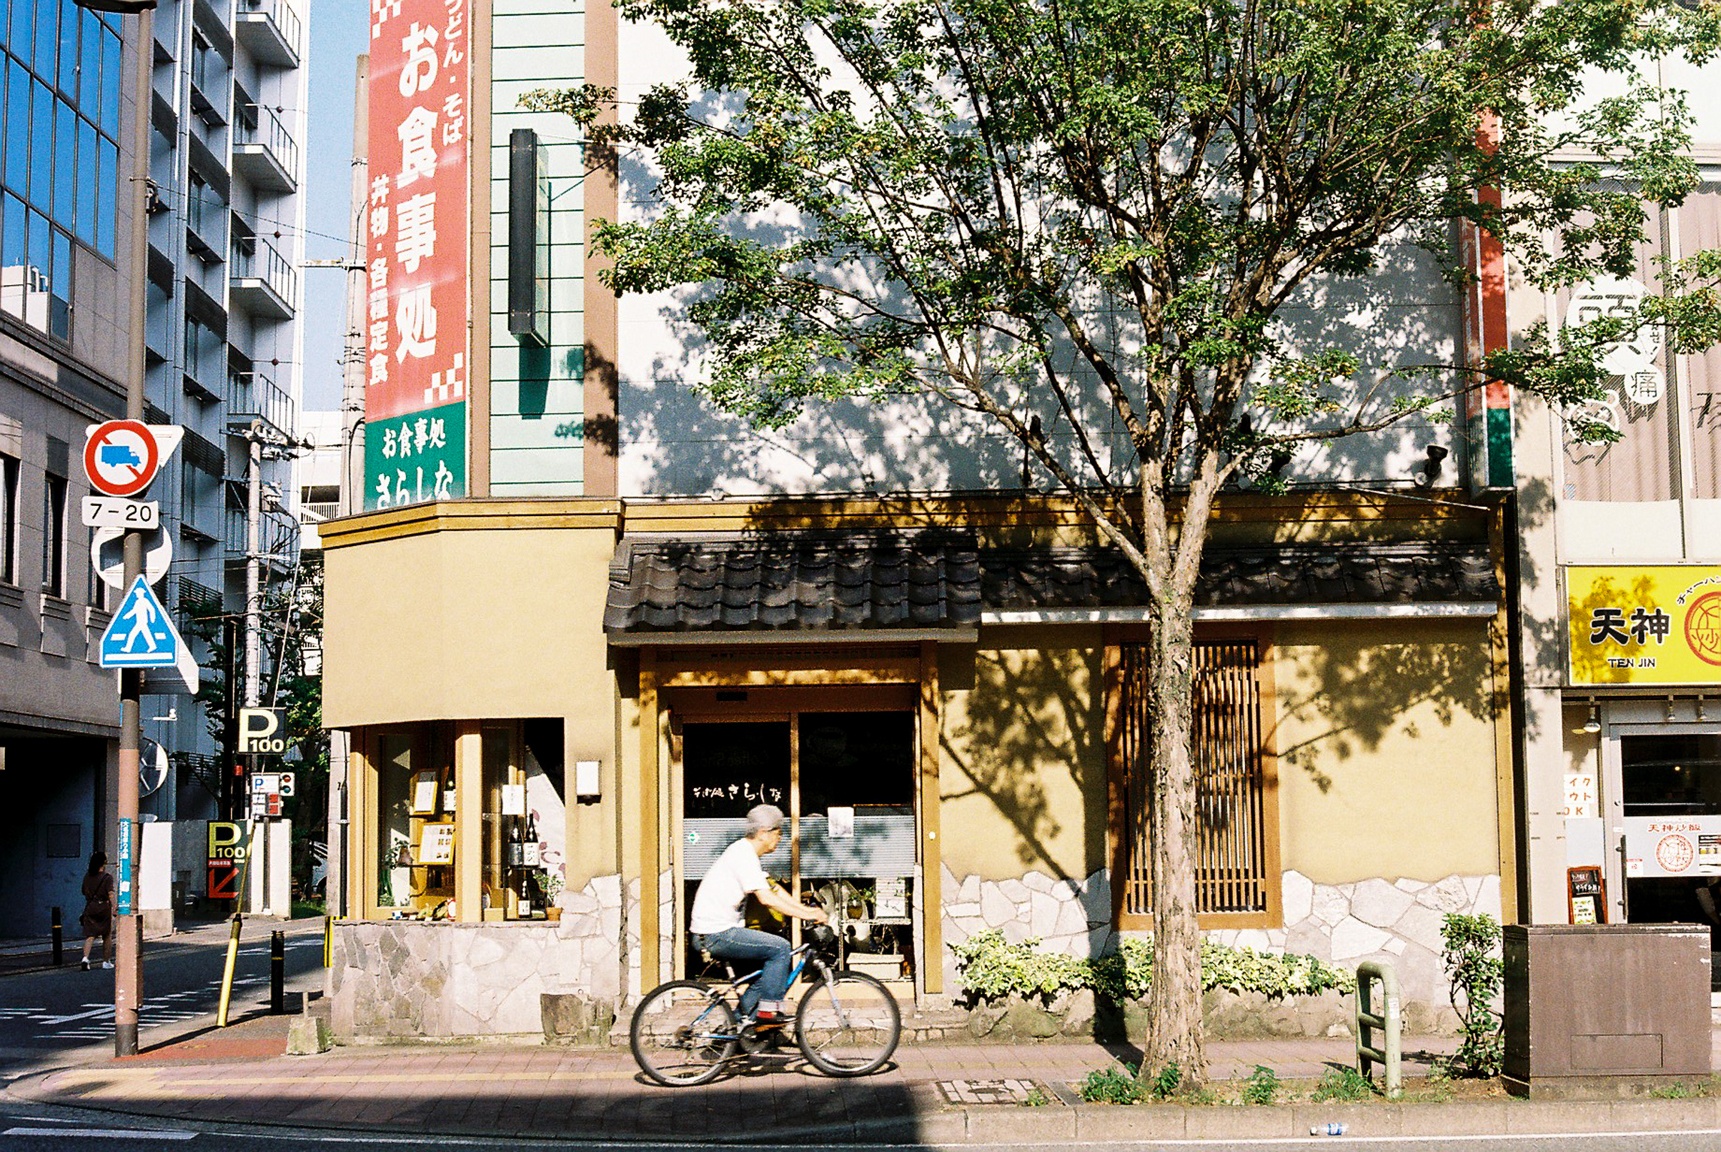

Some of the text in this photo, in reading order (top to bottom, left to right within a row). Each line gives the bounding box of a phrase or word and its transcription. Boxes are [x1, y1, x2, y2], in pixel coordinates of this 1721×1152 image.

[395, 21, 439, 364] お食事処
[369, 174, 389, 385] 丼物・各種定食
[382, 417, 447, 459] お食事処
[375, 460, 454, 510] さらしな
[90, 503, 151, 522] 7-20
[1590, 608, 1669, 645] 天神
[1608, 658, 1656, 668] TEN JIN
[239, 709, 278, 752] P
[249, 739, 284, 752] 100
[209, 822, 241, 858] P
[217, 847, 245, 858] 100
